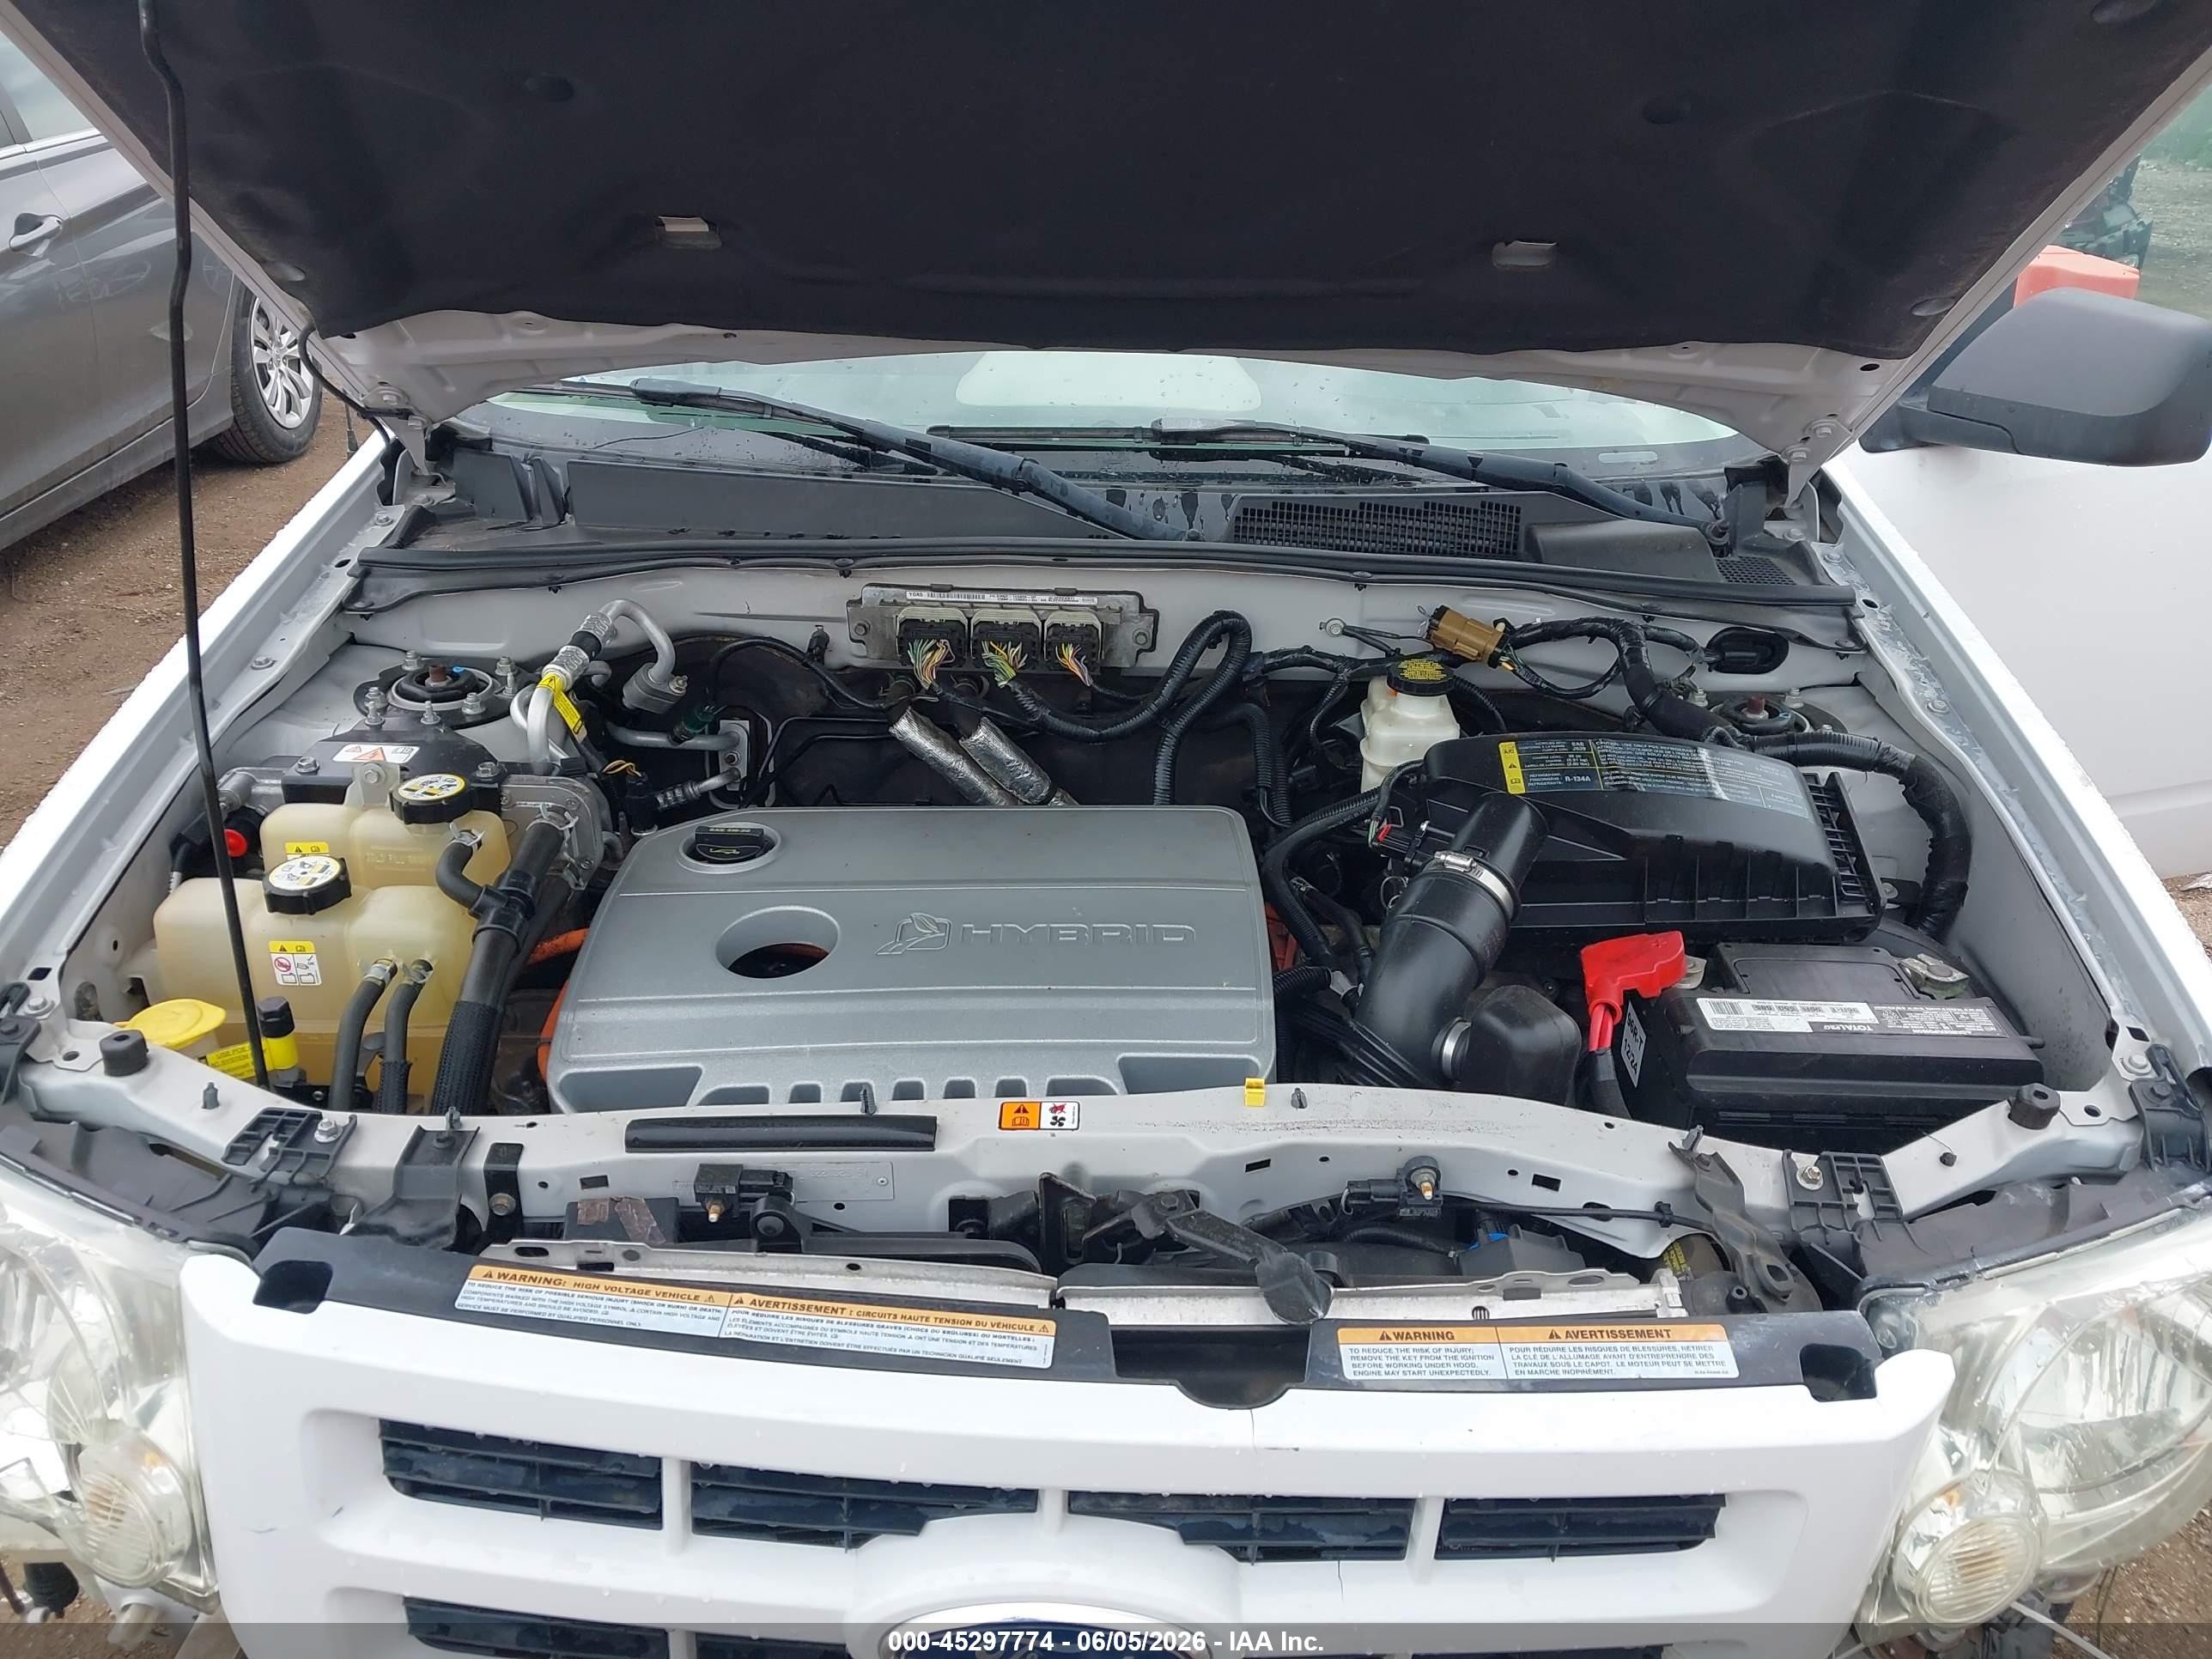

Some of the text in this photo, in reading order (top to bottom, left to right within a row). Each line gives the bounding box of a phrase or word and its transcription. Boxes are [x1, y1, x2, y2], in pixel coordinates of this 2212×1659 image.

[961, 924, 1195, 945] HYBRID
[497, 1272, 701, 1301] WARNING: HIGH VOLTAGE VEHICLE
[749, 1298, 847, 1315] AVERTISSEMENT
[856, 1310, 898, 1320] CIRCUITS
[901, 1314, 931, 1322] HAUTE
[933, 1316, 973, 1327] TENSION
[1392, 1331, 1455, 1340] WARNING
[1565, 1329, 1672, 1340] AVERTISSEMENT
